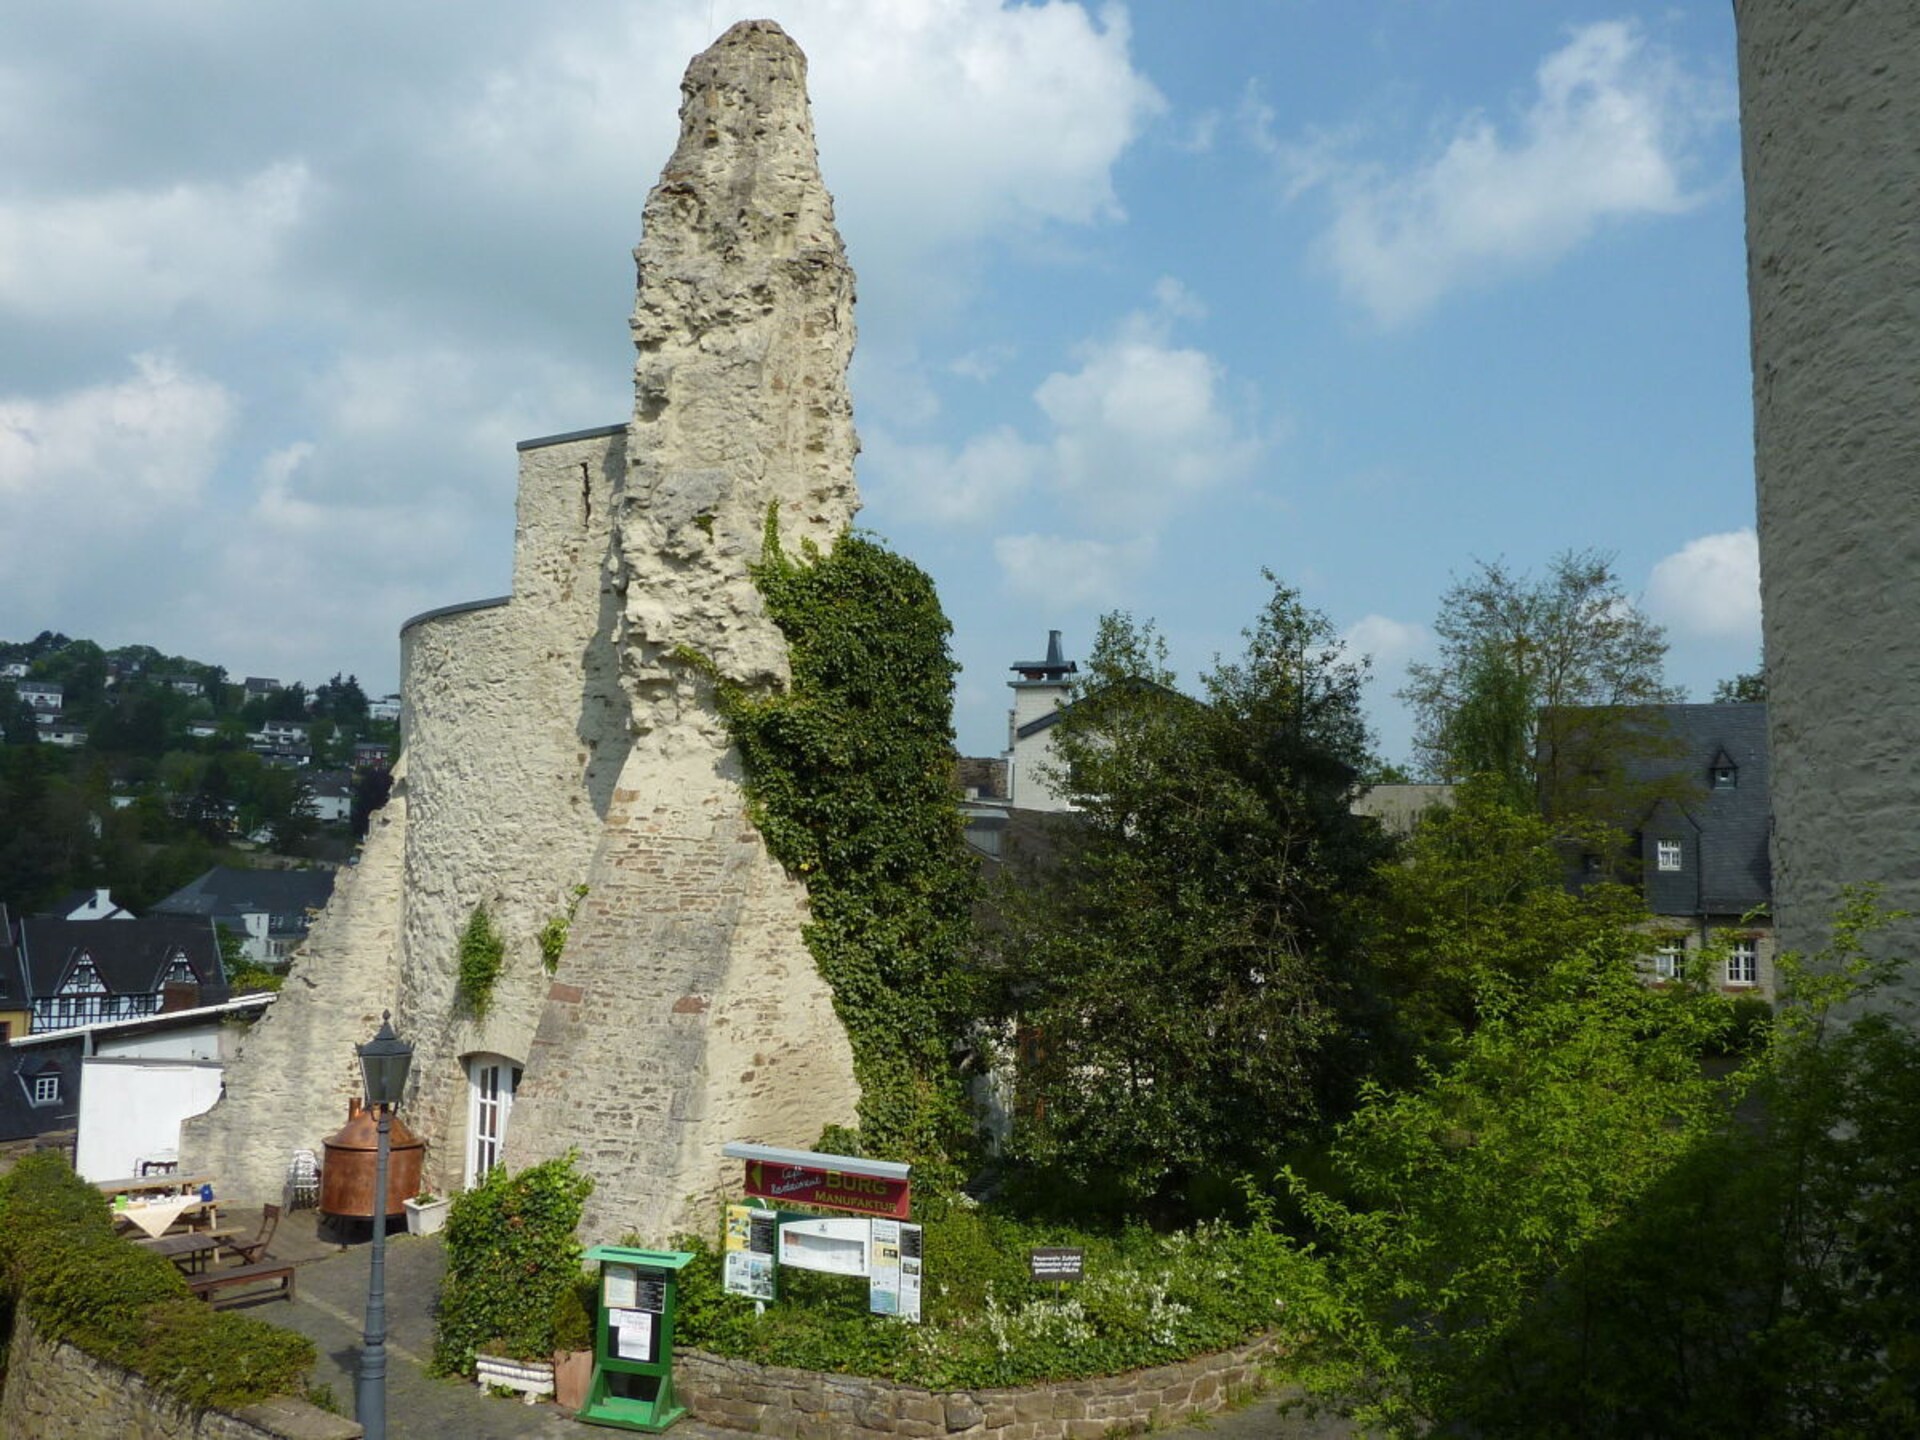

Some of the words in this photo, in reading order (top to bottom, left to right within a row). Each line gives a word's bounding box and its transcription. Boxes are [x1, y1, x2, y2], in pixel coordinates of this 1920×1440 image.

[770, 1177, 822, 1195] Restaurant
[826, 1169, 888, 1194] BURG
[815, 1190, 897, 1214] MANUFAKTUR
